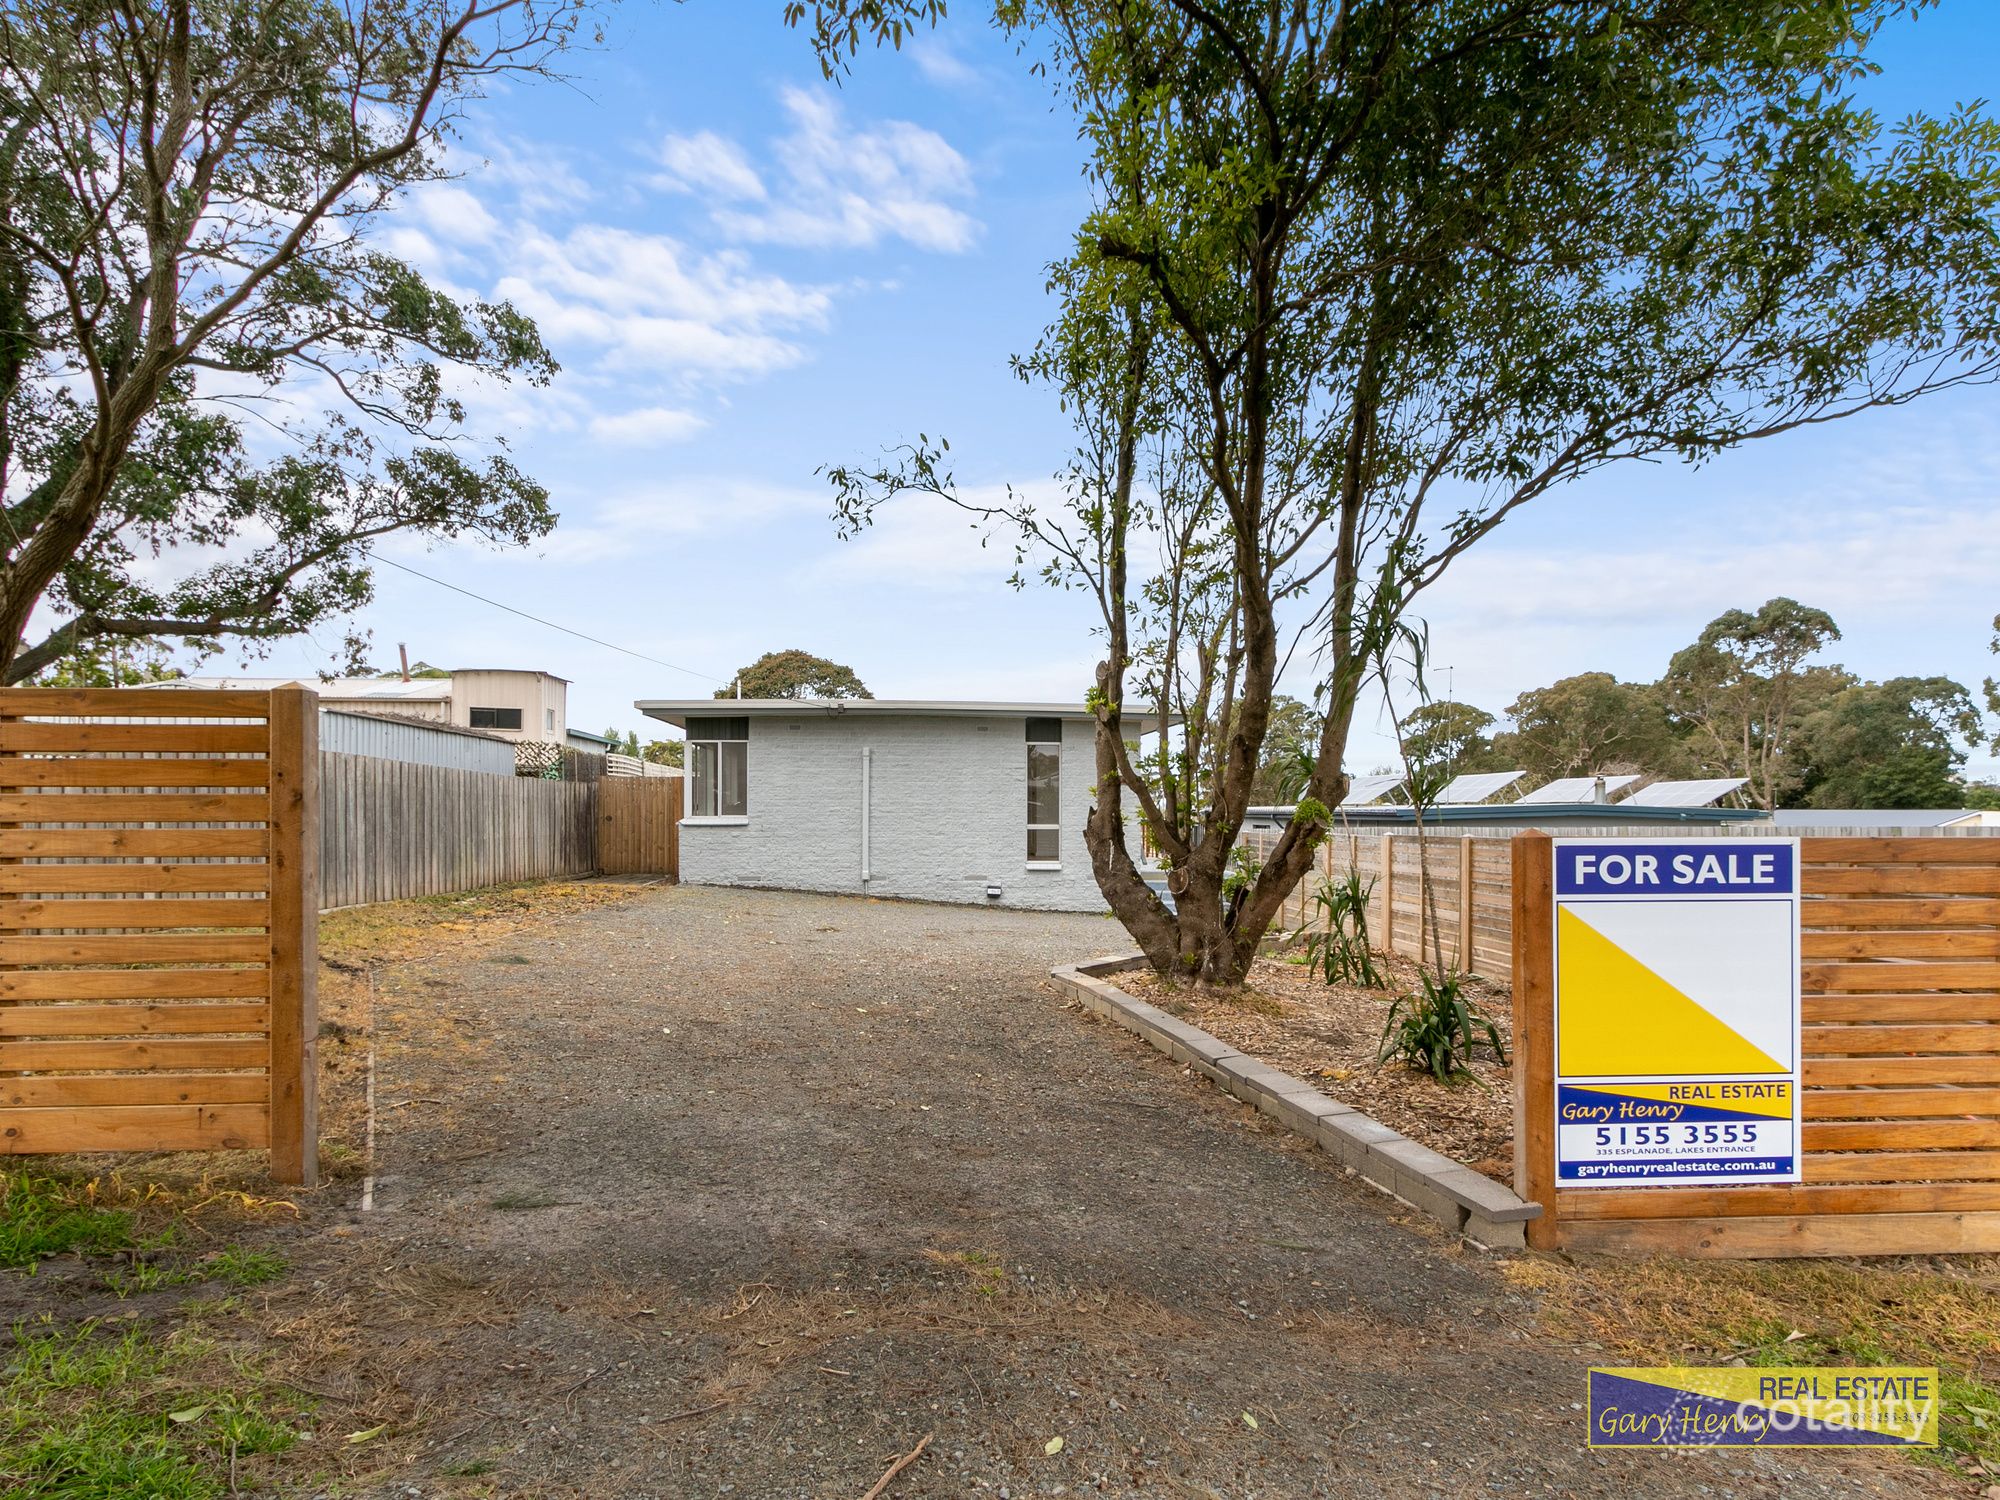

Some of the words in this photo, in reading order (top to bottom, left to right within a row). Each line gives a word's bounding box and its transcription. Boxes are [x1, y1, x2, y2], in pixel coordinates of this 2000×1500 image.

[1575, 854, 1661, 885] FOR
[1672, 854, 1775, 885] SALE
[1669, 1085, 1715, 1100] REAL
[1721, 1084, 1786, 1099] ESTATE
[1562, 1102, 1614, 1123] Gary
[1619, 1101, 1685, 1121] Henry
[1595, 1126, 1670, 1146] 5155
[1683, 1124, 1757, 1144] 3555
[1615, 1147, 1673, 1155] ESPLANADE,
[1675, 1146, 1704, 1154] LAKES
[1706, 1145, 1756, 1153] ENTRANCE
[1577, 1161, 1776, 1177] garyhenryrealestate.com.au
